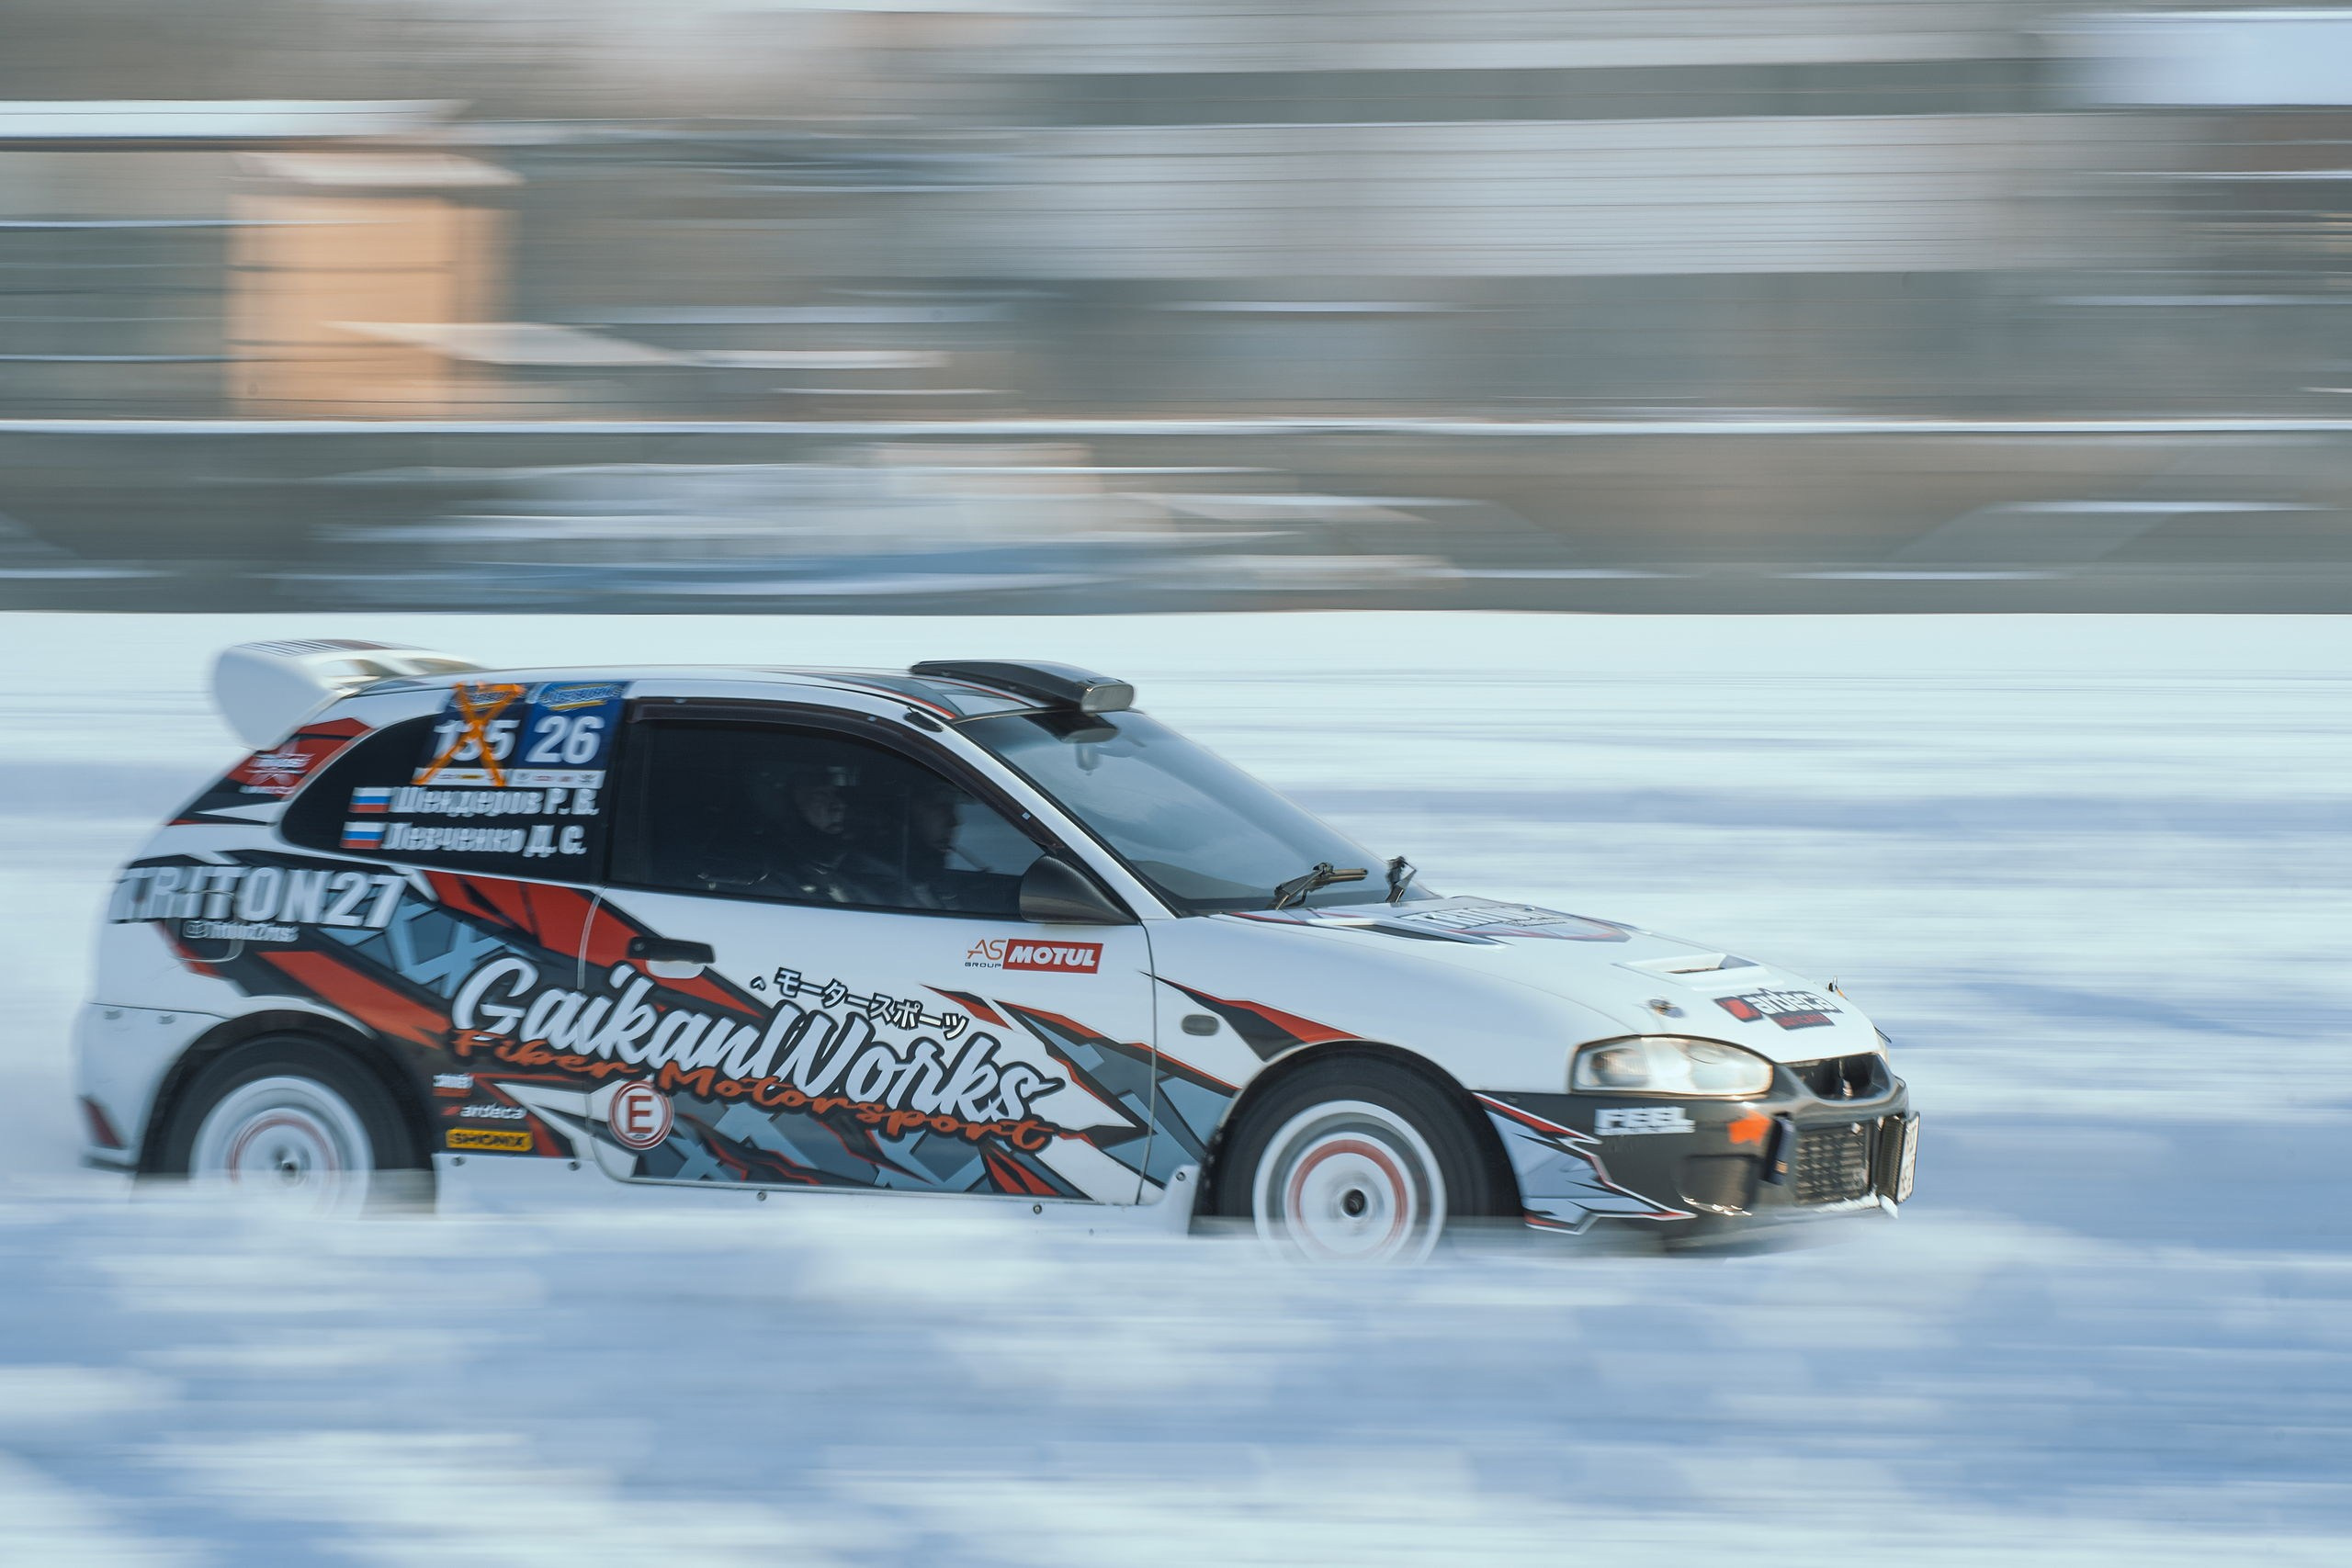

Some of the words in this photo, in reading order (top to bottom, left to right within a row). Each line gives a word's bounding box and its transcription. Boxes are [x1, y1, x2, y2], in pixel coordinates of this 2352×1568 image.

[525, 715, 605, 764] 26
[108, 865, 407, 929] TRITON27
[967, 939, 1007, 961] AS
[1008, 945, 1096, 967] MOTUL
[775, 967, 969, 1039] モータースポーツ
[626, 1095, 653, 1134] E
[658, 1060, 1056, 1151] Motorsport
